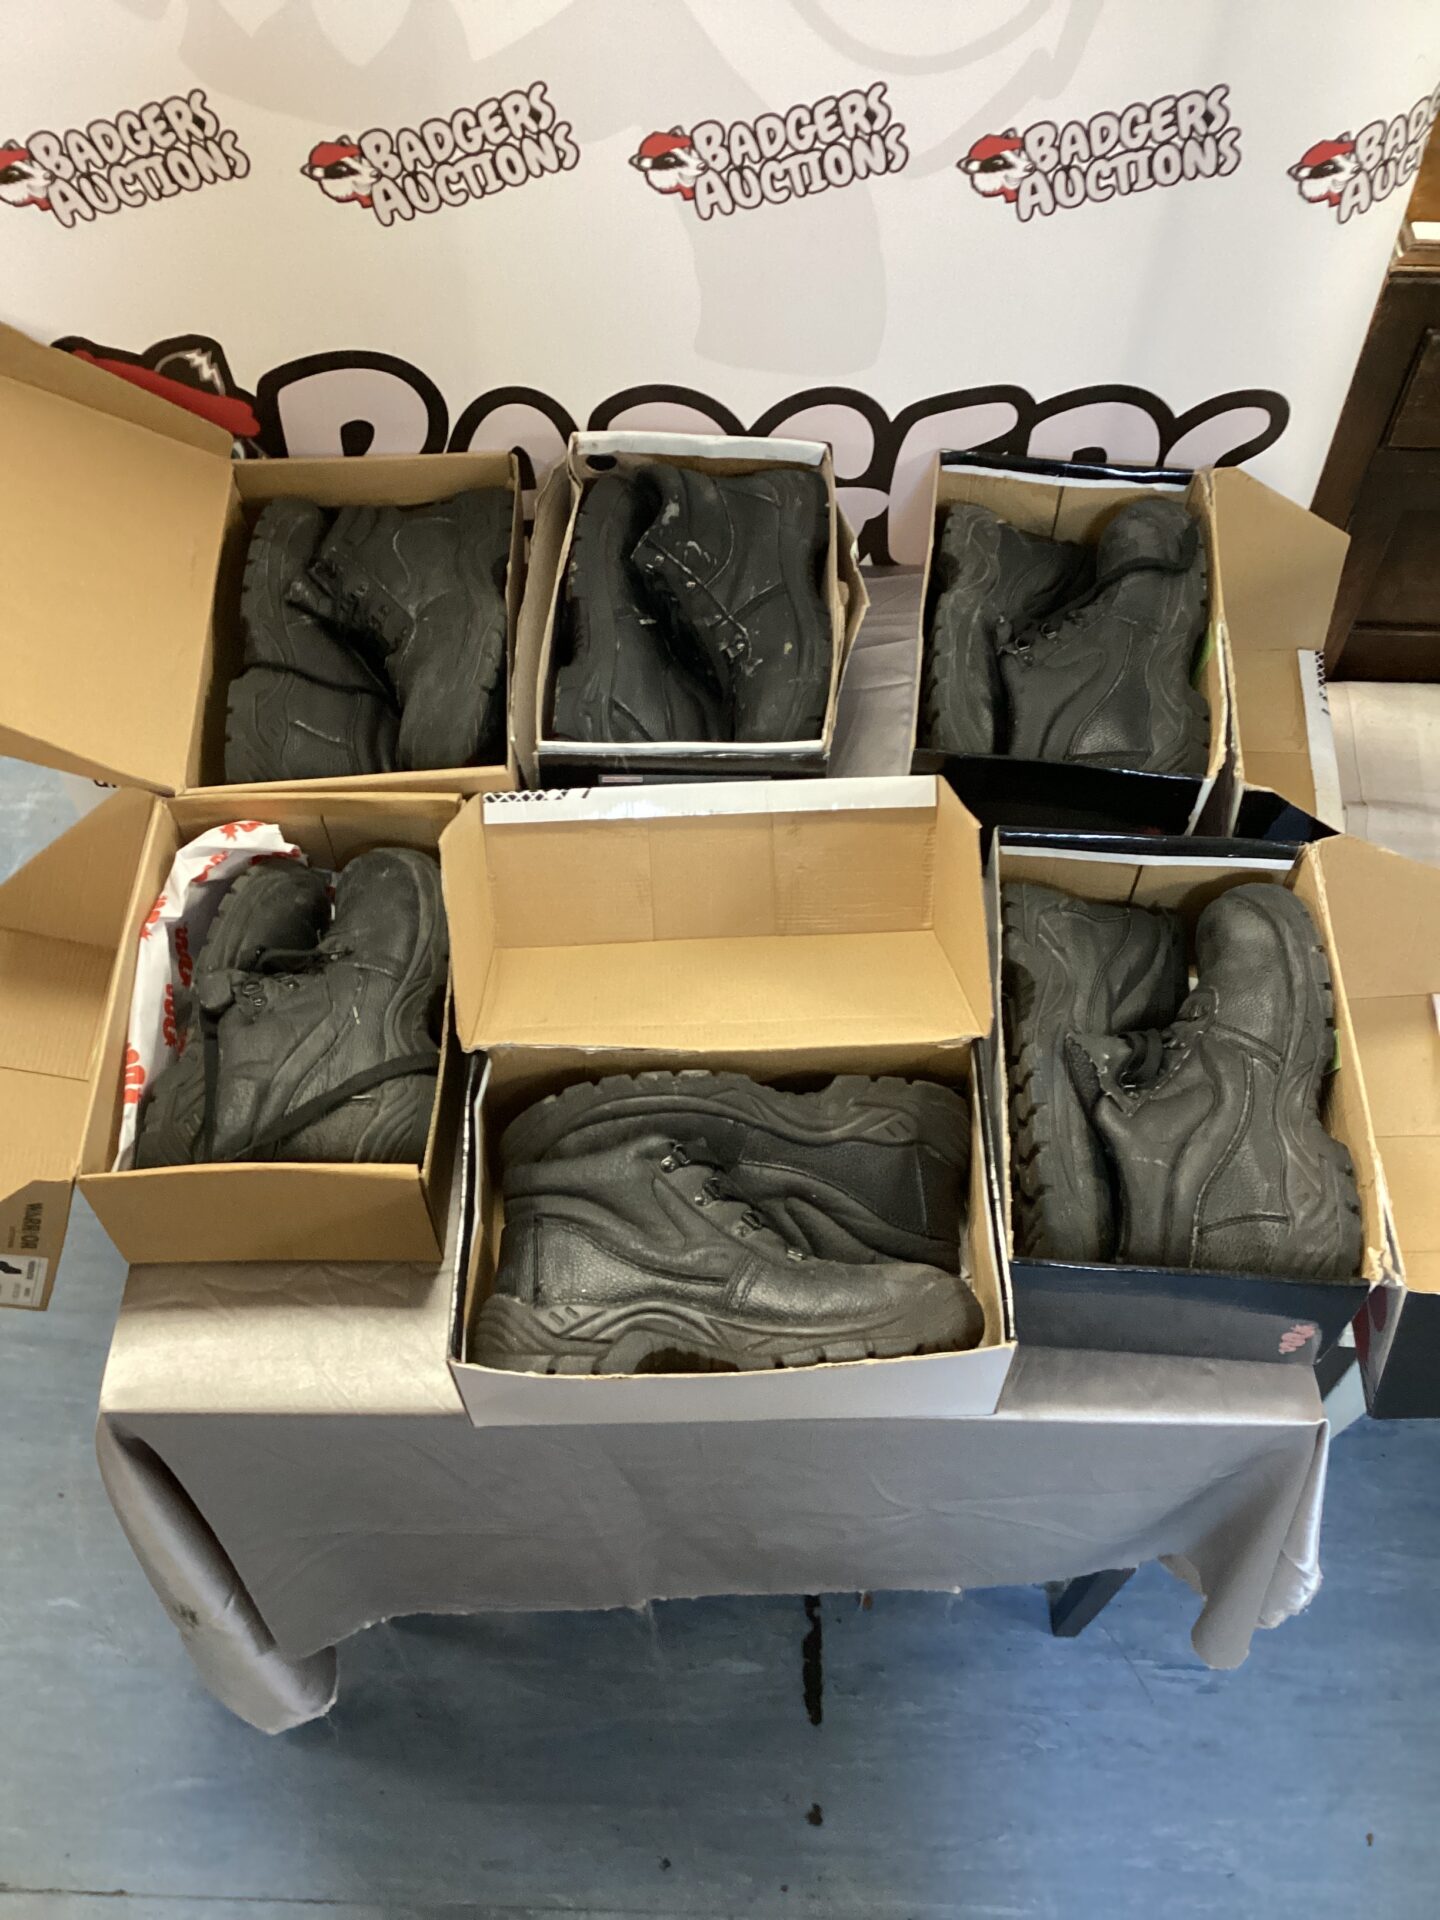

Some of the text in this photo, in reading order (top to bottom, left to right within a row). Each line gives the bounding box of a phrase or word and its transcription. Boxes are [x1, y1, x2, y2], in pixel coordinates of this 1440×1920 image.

[25, 88, 219, 181] BADGERS
[358, 81, 556, 179] BADGERS
[372, 121, 580, 227] AUCTIONS
[690, 81, 891, 173] BADGERS
[694, 122, 909, 221] AUCTIONS
[1016, 127, 1241, 222] AUCTIONS
[1023, 84, 1230, 173] BADGERS
[49, 130, 250, 228] AUCTIONS
[21, 1203, 43, 1249] WARRIOR
